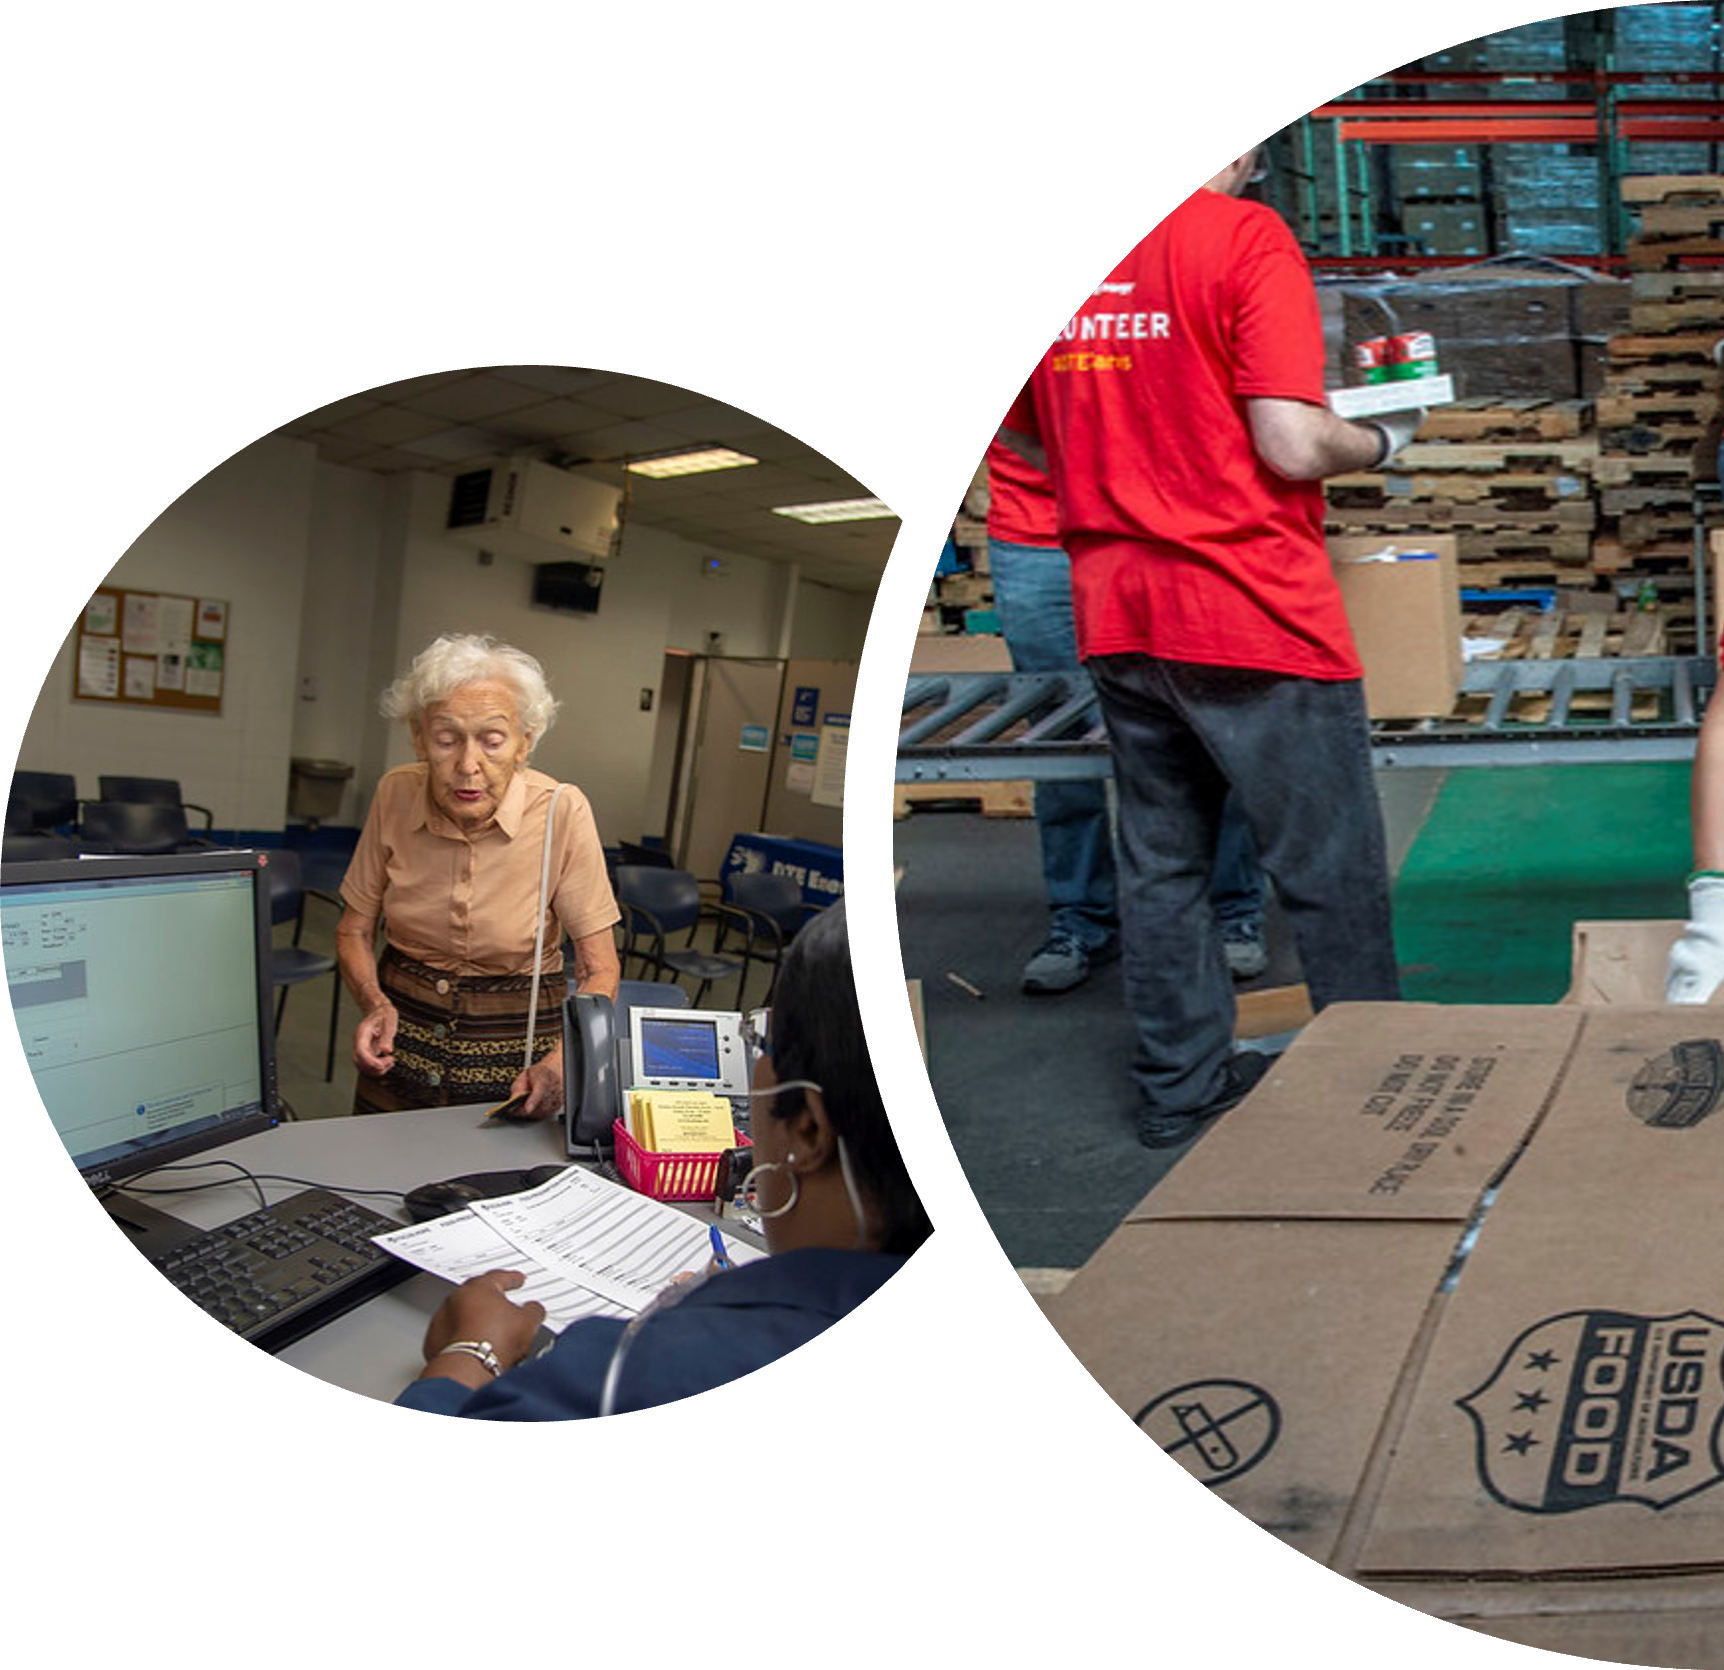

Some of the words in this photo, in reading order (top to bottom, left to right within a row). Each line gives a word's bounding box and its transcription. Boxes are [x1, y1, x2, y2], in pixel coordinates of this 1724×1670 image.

[1055, 312, 1171, 341] UNTEER
[1393, 1054, 1425, 1071] DO
[1430, 1055, 1462, 1071] DO
[1455, 1056, 1498, 1090] STORE
[1562, 1327, 1637, 1487] FOOD
[1645, 1328, 1711, 1482] USDA
